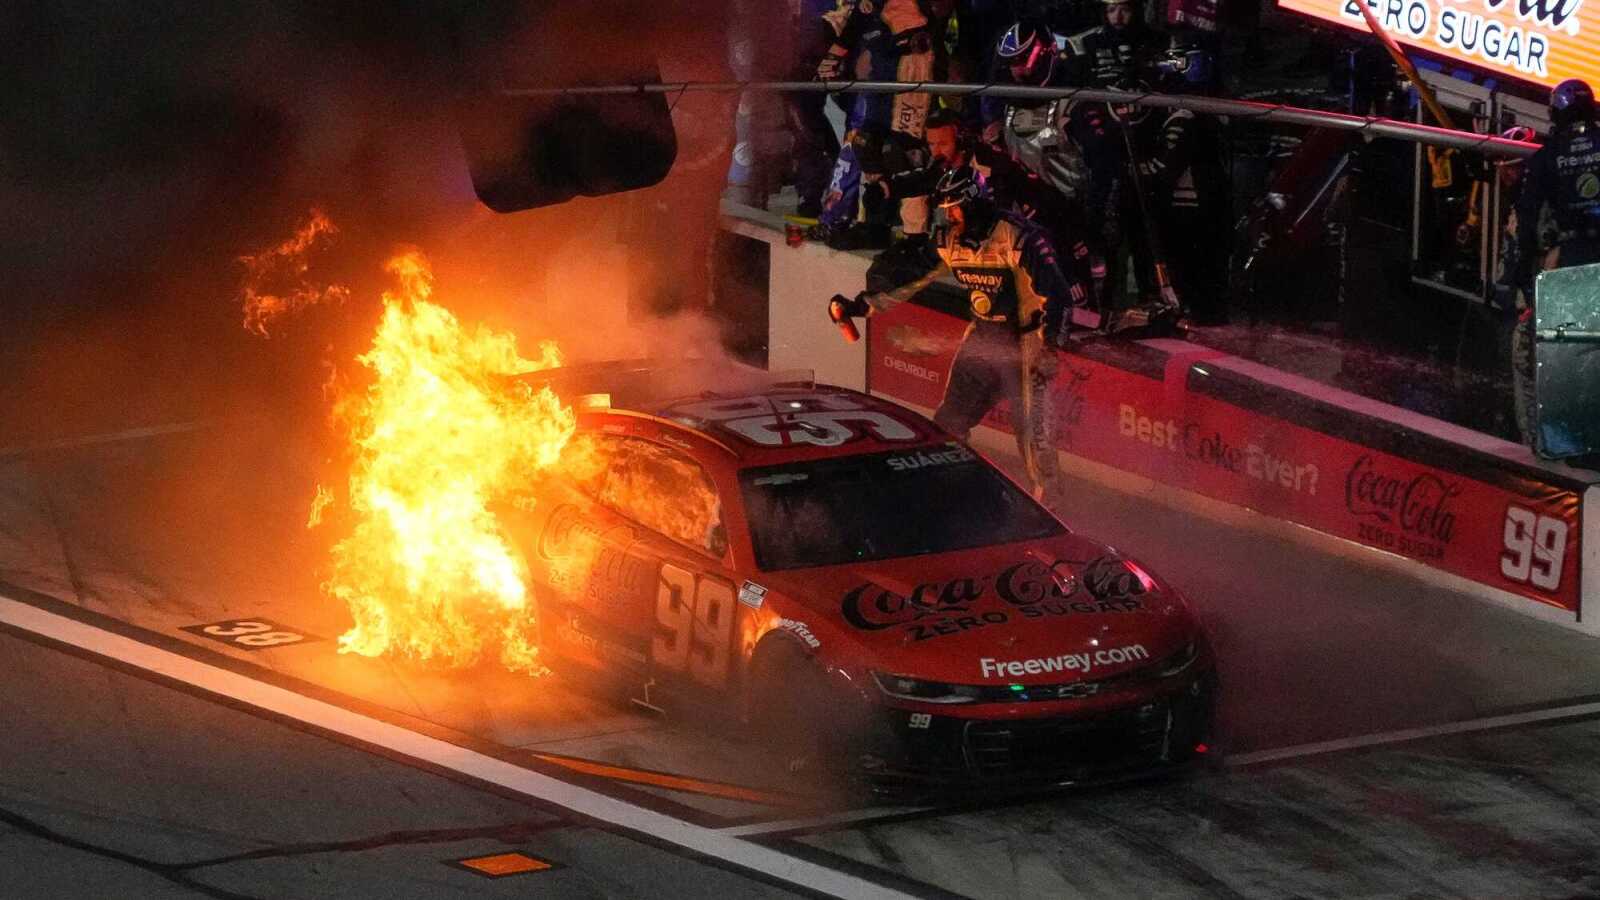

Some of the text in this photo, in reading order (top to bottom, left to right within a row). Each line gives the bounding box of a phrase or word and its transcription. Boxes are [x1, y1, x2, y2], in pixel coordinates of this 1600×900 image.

[1344, 0, 1427, 35] ZRO
[1439, 10, 1546, 71] SUGAR
[884, 356, 940, 384] CHEVROLET
[1119, 403, 1179, 453] Best
[1182, 422, 1244, 475] Coke
[1245, 443, 1319, 496] Ever?
[1358, 523, 1395, 547] ZERO
[1501, 506, 1568, 591] 99
[203, 621, 305, 646] 38
[653, 563, 735, 676] 99
[904, 600, 1142, 641] ZERO SUGAR
[980, 642, 1150, 679] Freeway.com
[908, 712, 932, 729] 99
